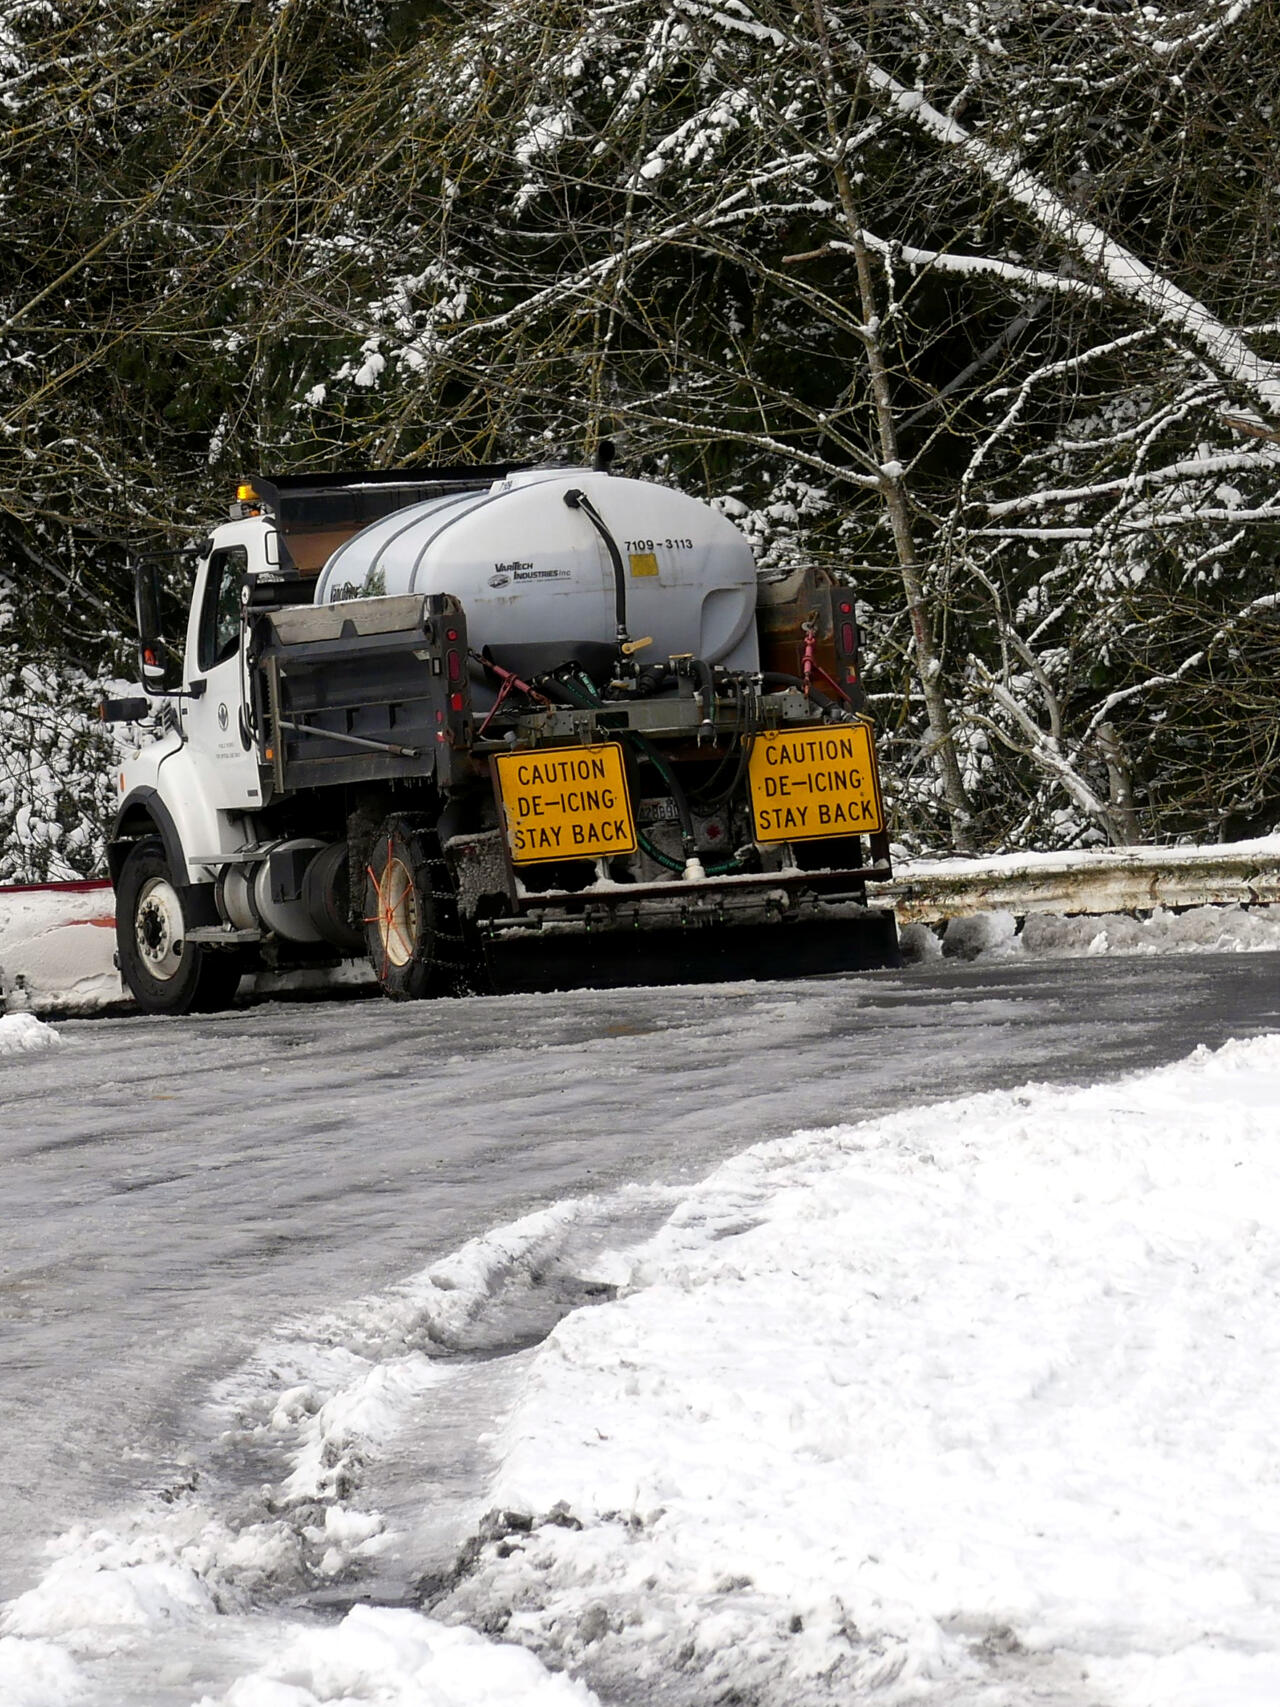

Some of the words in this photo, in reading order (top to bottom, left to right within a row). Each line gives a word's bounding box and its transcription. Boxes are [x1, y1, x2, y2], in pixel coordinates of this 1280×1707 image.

[766, 738, 853, 765] CAUTION
[518, 759, 605, 785] CAUTION
[765, 769, 861, 797] DE-ICING
[518, 789, 614, 817] DE-ICING
[760, 806, 808, 829] STAY
[818, 800, 873, 824] BACK
[515, 826, 561, 849] STAY
[572, 820, 627, 844] BACK
